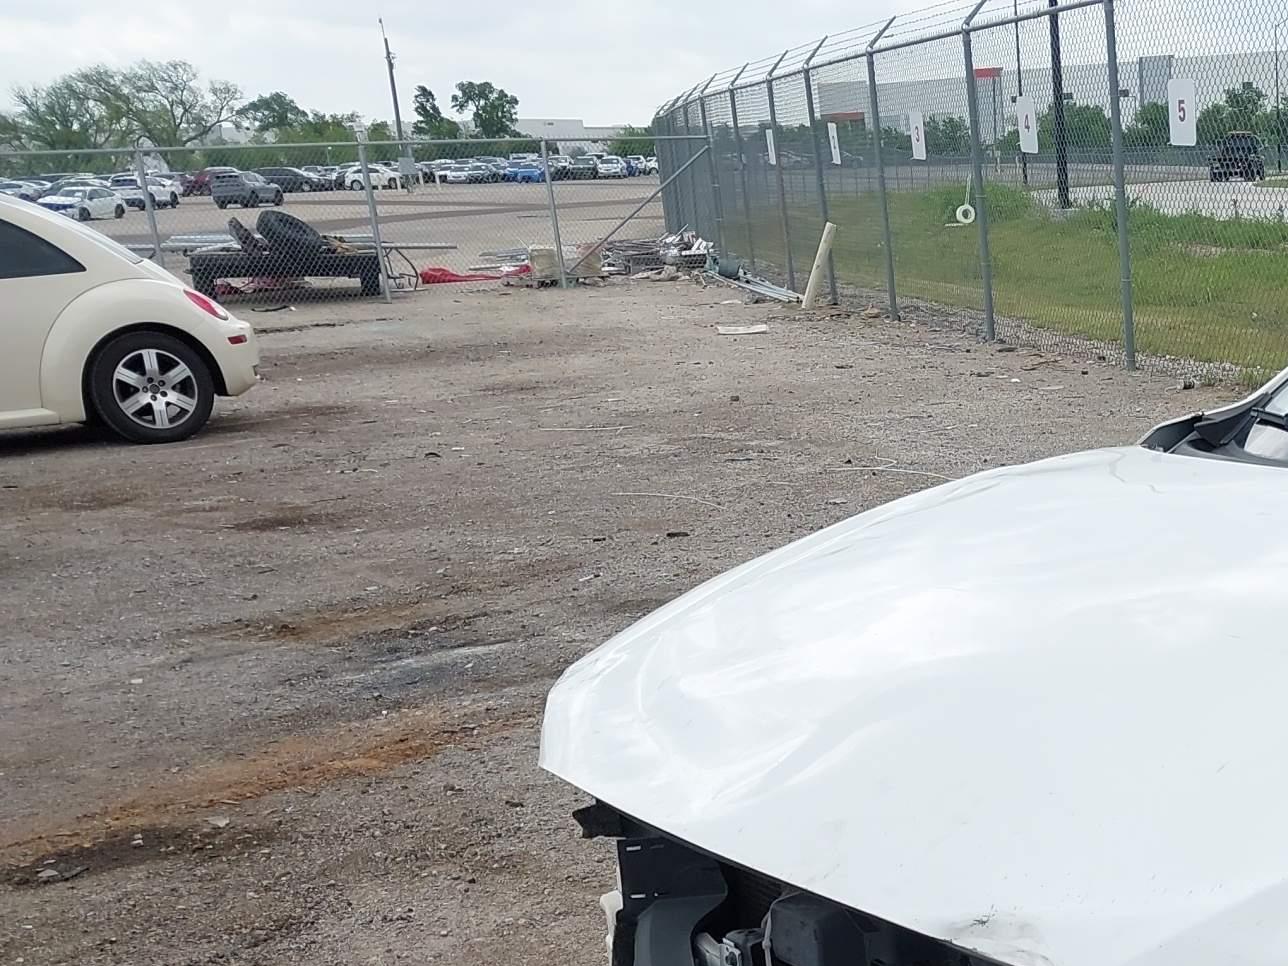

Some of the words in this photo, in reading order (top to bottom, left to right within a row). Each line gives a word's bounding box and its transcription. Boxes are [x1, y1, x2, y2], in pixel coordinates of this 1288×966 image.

[1178, 99, 1186, 122] 5
[1024, 114, 1031, 132] 4
[914, 125, 920, 143] 3
